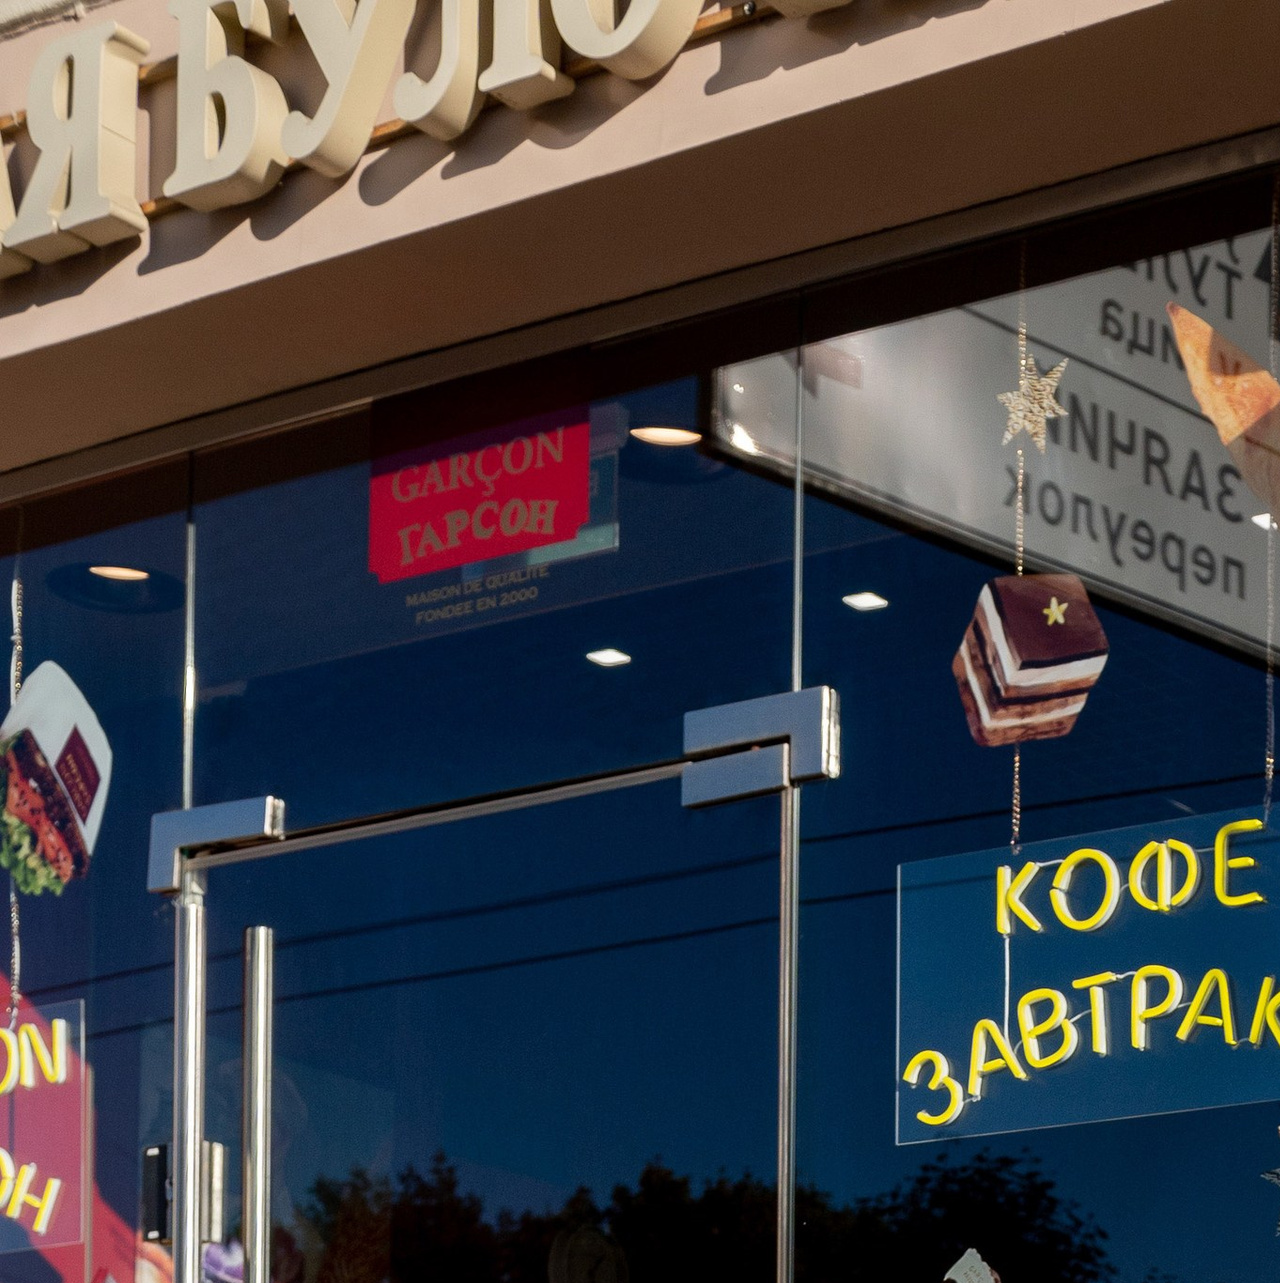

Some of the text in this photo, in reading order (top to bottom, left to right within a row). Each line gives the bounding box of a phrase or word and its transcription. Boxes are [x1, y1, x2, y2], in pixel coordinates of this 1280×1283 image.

[0, 20, 150, 264] Я
[393, 428, 564, 502] GARÇON
[398, 497, 560, 566] ГАРСОН
[996, 818, 1266, 934] КОФЕ
